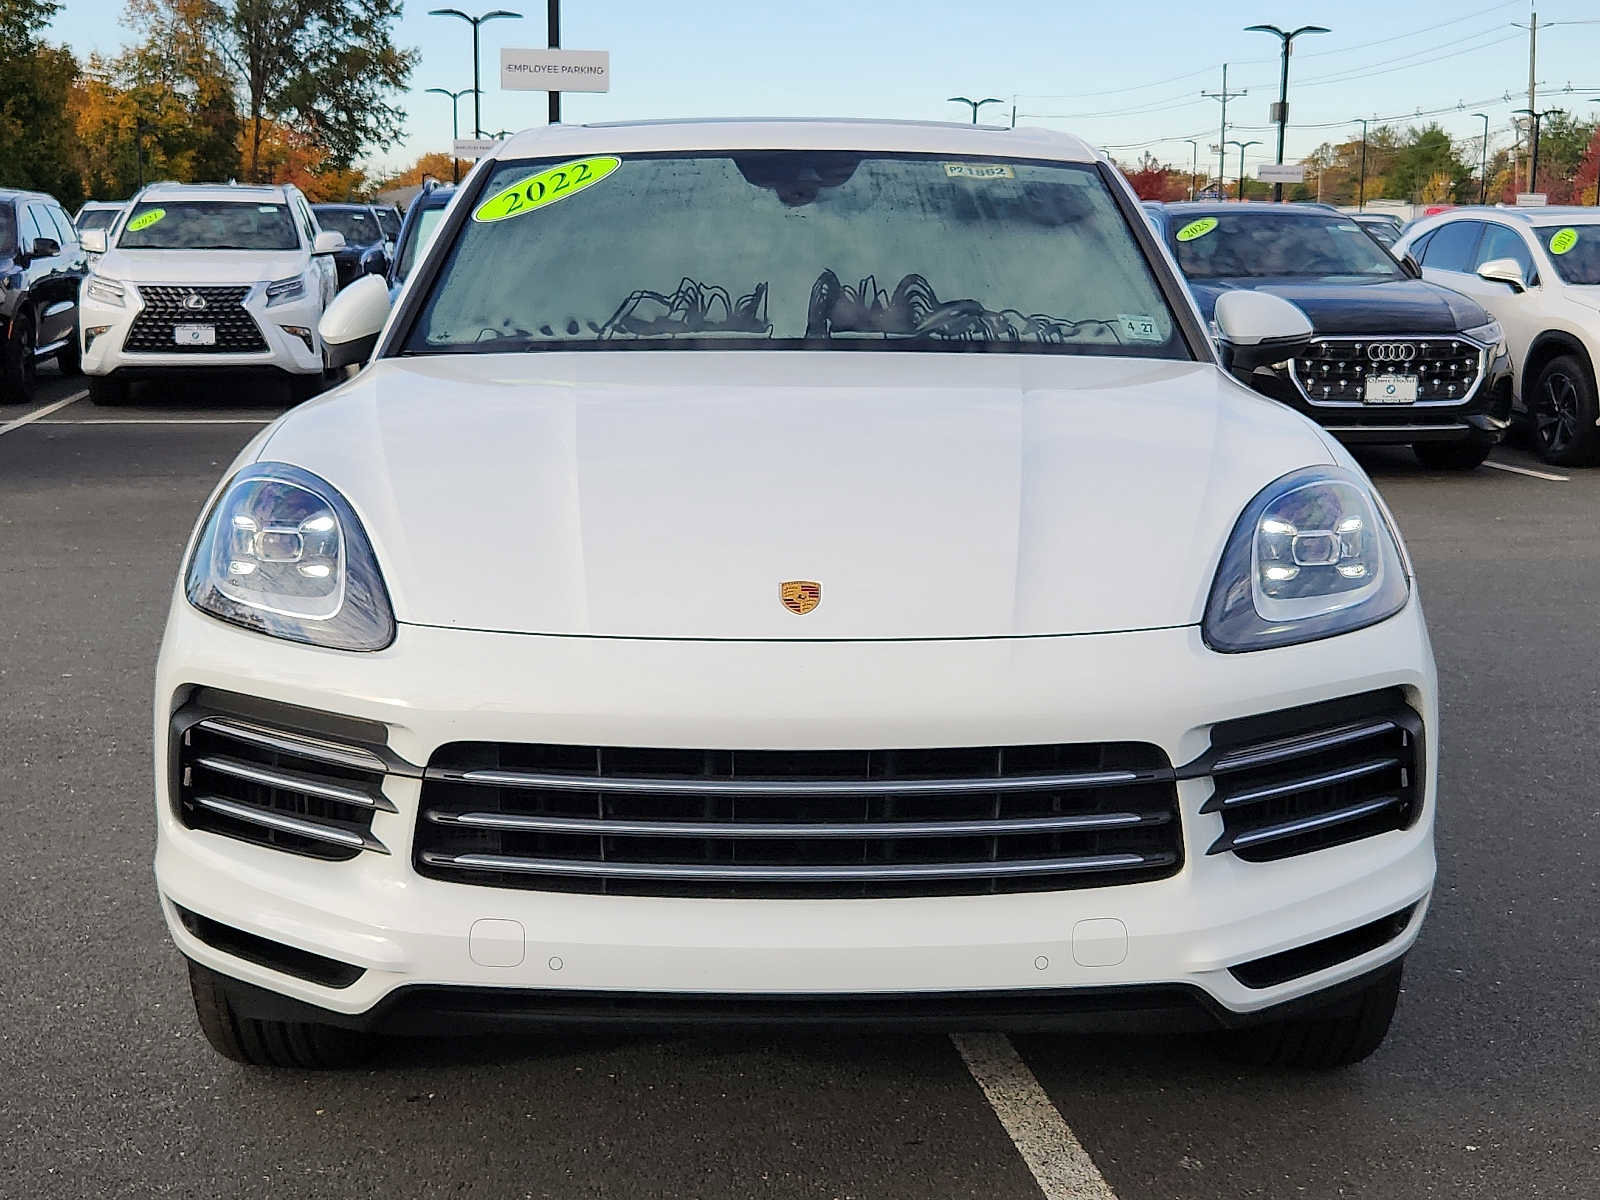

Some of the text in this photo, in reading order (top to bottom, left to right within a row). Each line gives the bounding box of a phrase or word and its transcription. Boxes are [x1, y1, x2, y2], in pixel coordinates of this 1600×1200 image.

[506, 64, 604, 75] EMPLOYEE PARKING
[504, 164, 592, 214] 2022
[1141, 323, 1152, 333] 27
